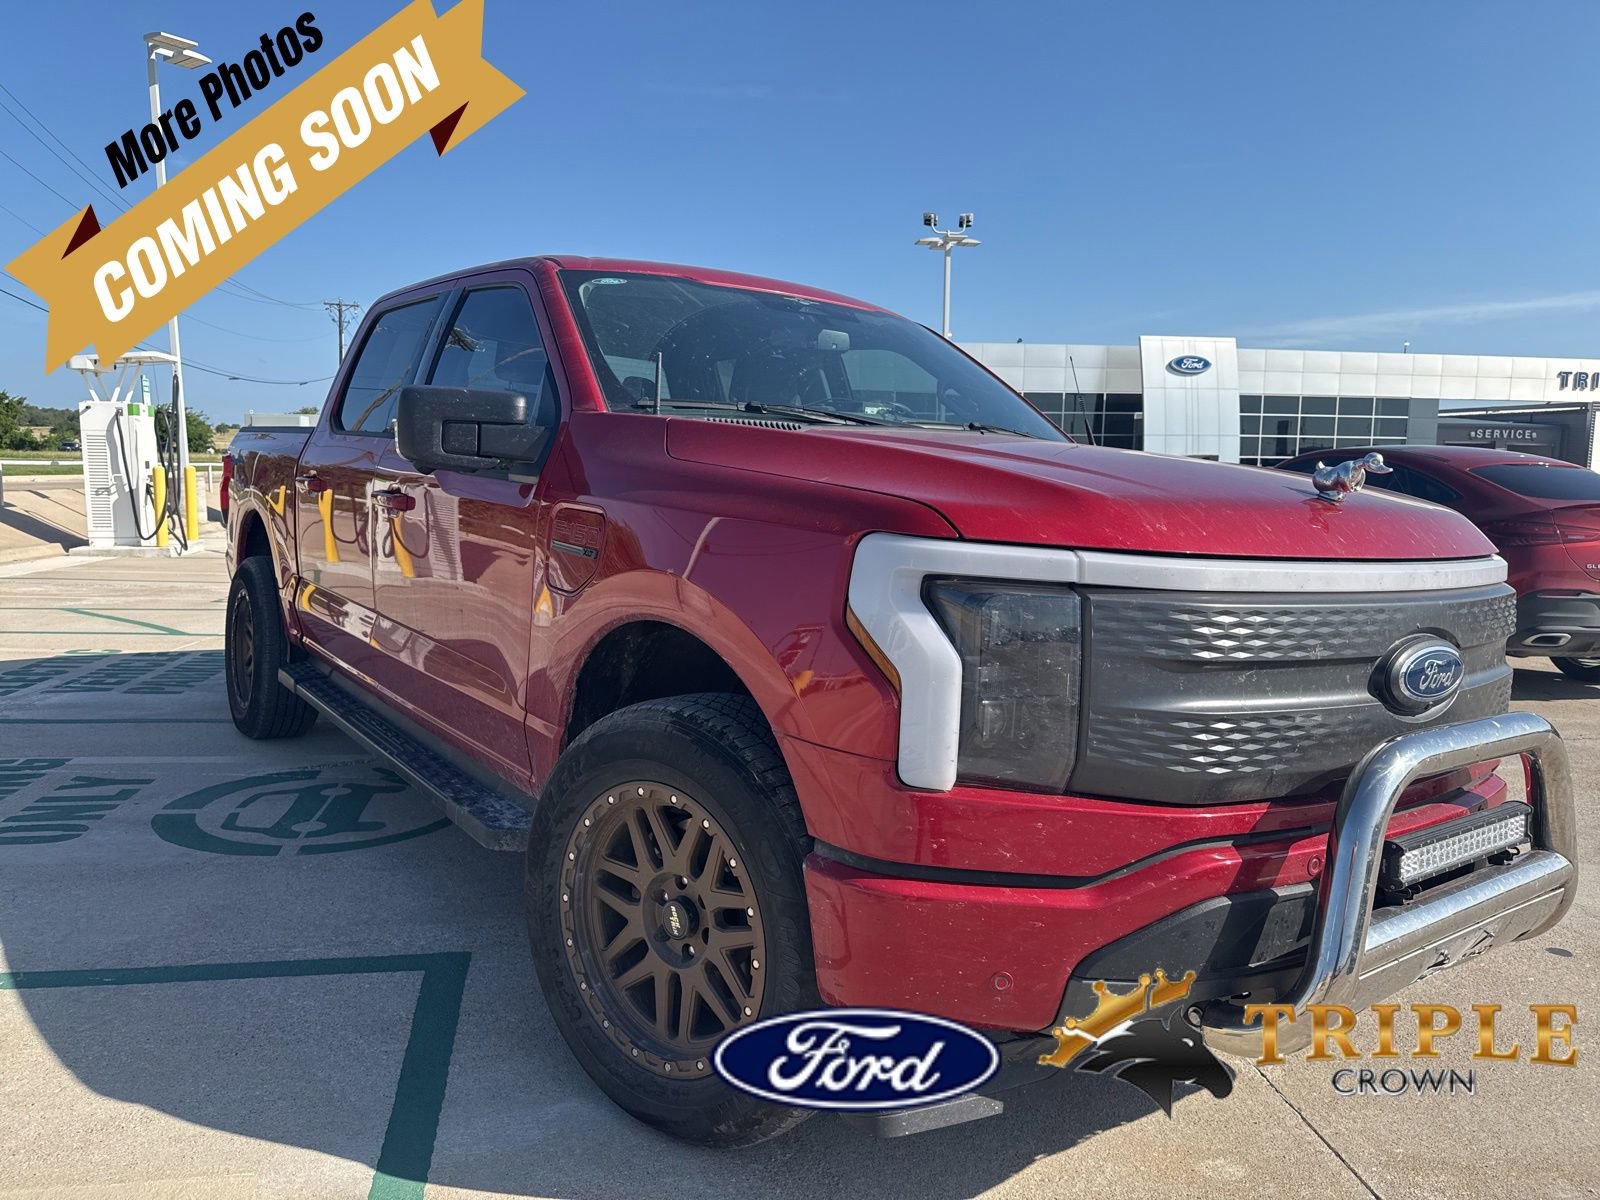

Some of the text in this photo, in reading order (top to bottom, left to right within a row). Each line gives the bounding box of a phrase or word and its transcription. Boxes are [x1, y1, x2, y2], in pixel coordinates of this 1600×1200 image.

[1181, 357, 1205, 369] Ford
[1556, 371, 1600, 391] TRI
[1476, 429, 1532, 439] SERVICE
[41, 652, 195, 694] VEHICLE
[1419, 659, 1455, 690] Ford
[0, 776, 156, 845] ONLY
